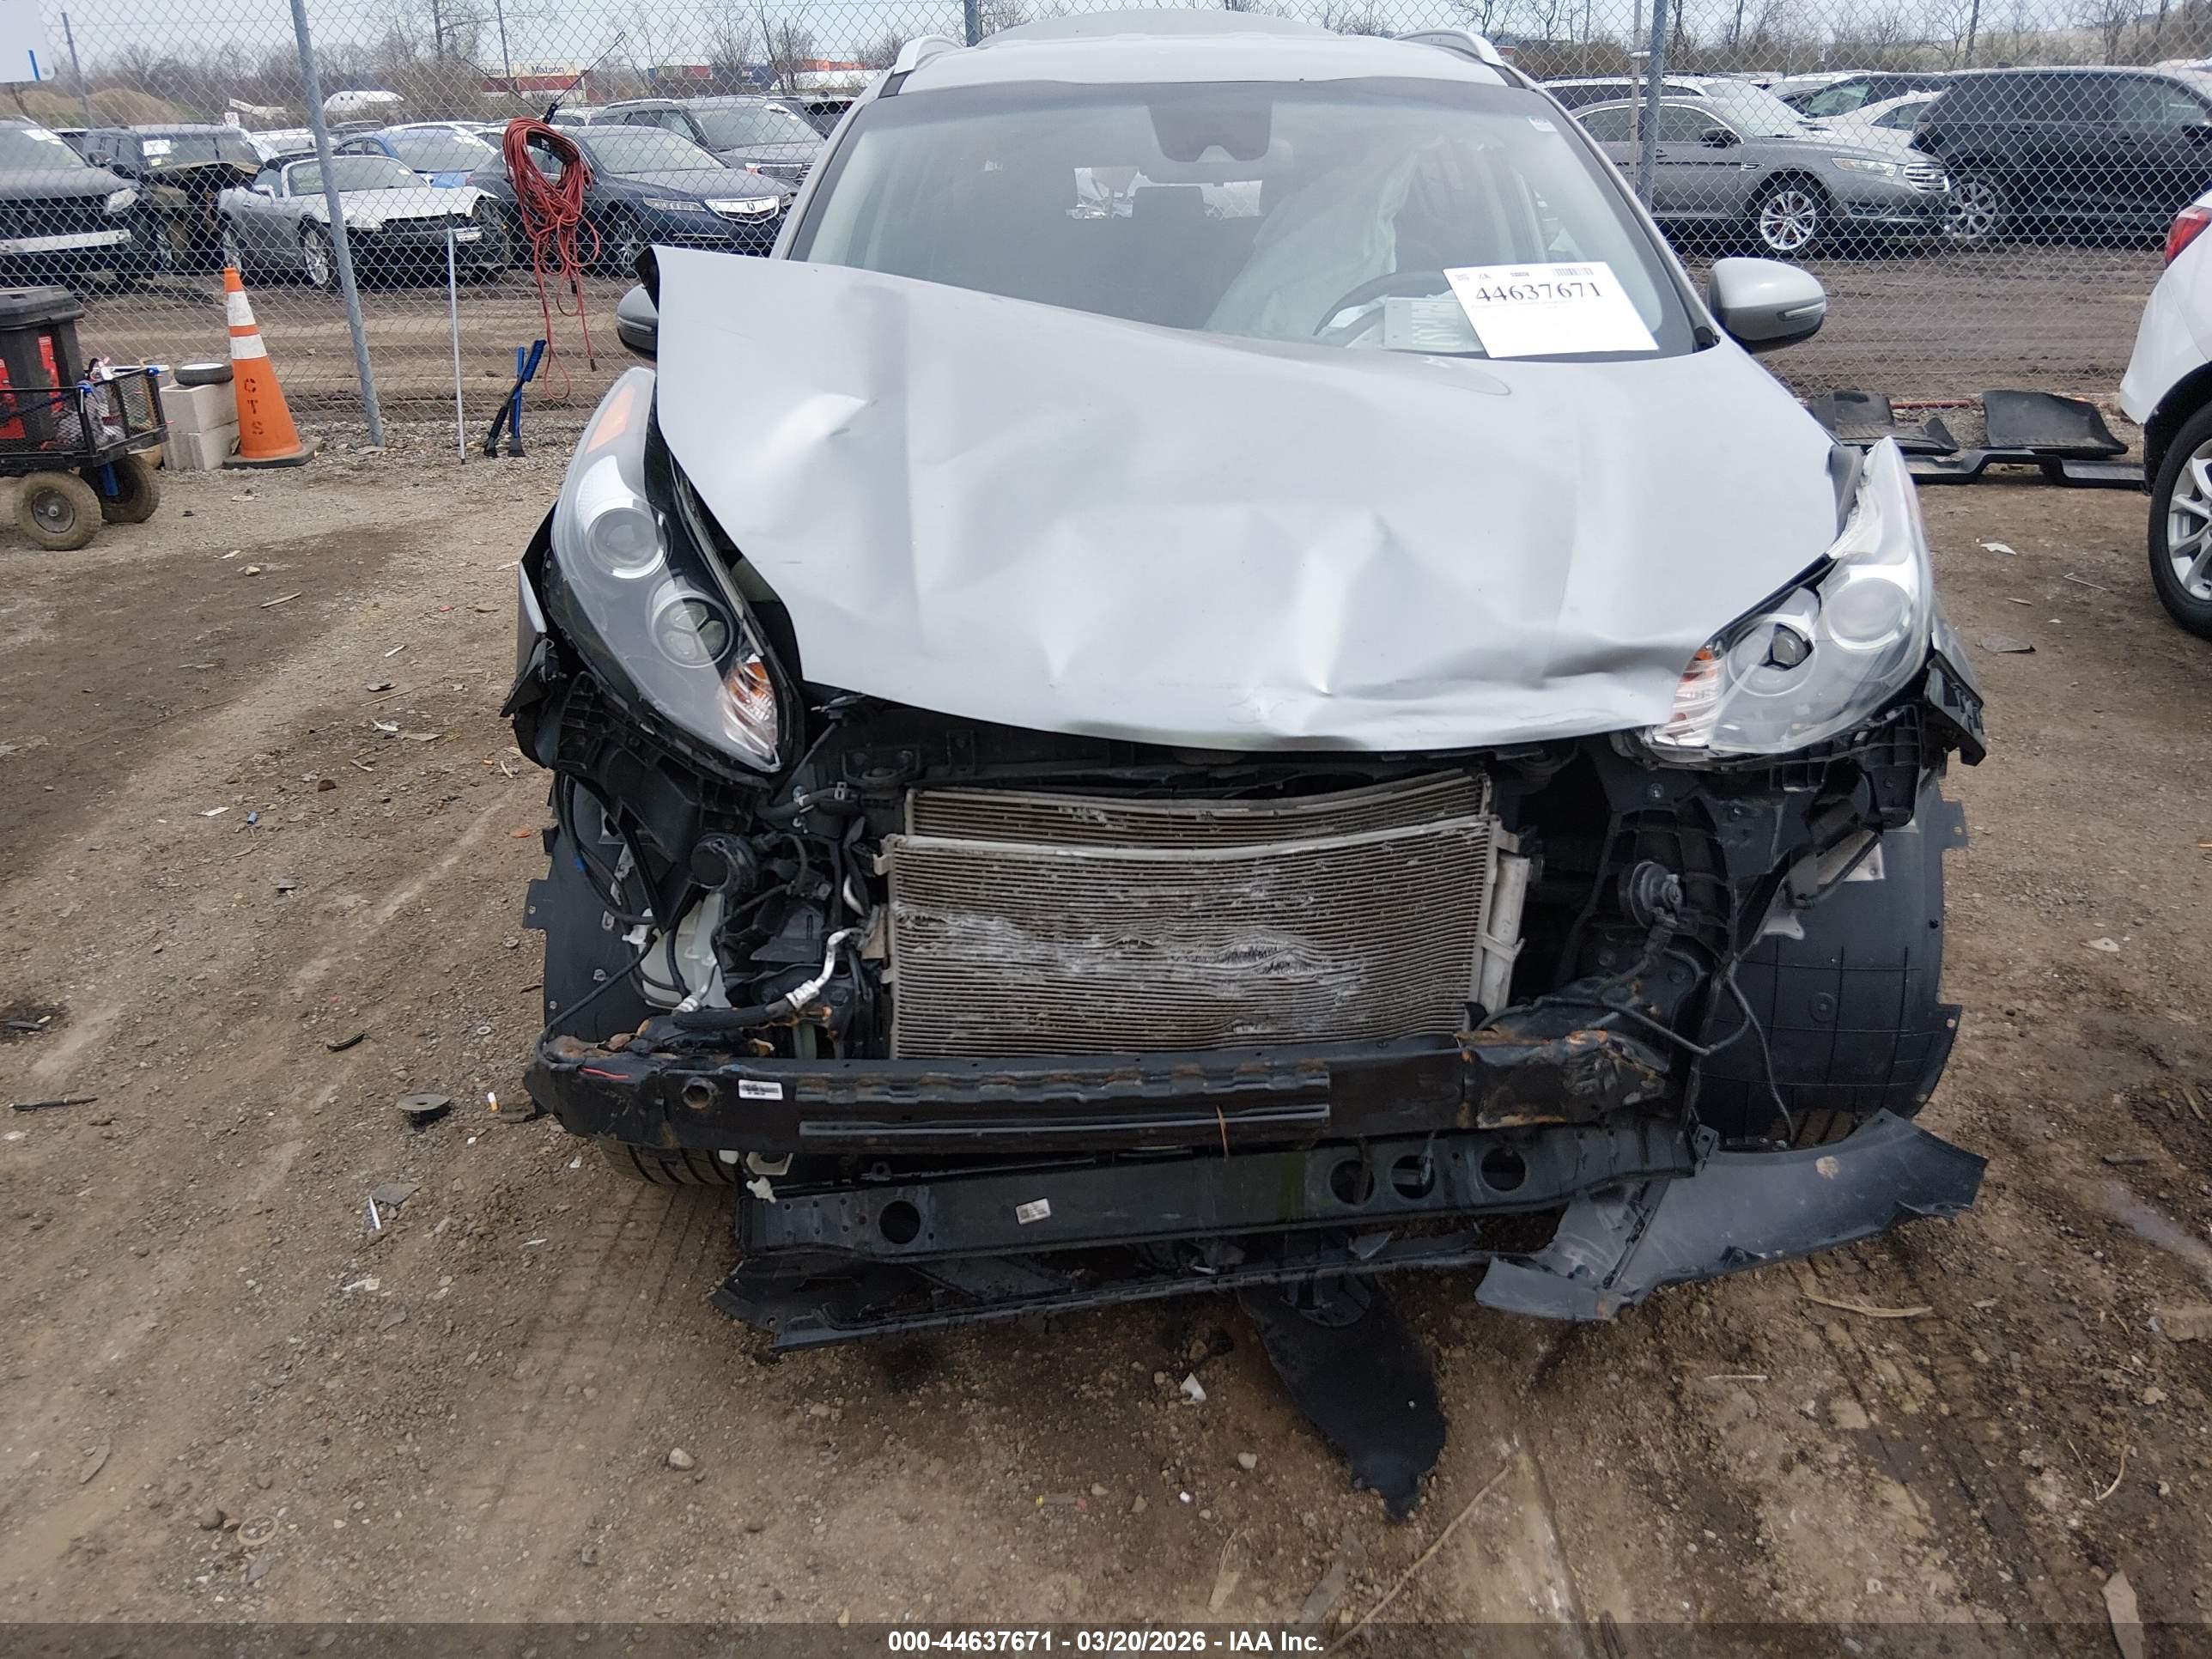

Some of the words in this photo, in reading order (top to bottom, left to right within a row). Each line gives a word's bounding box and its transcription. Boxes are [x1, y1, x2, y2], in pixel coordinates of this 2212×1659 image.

[531, 66, 565, 75] Matson
[1475, 282, 1603, 302] 44637671
[243, 377, 264, 436] CTS
